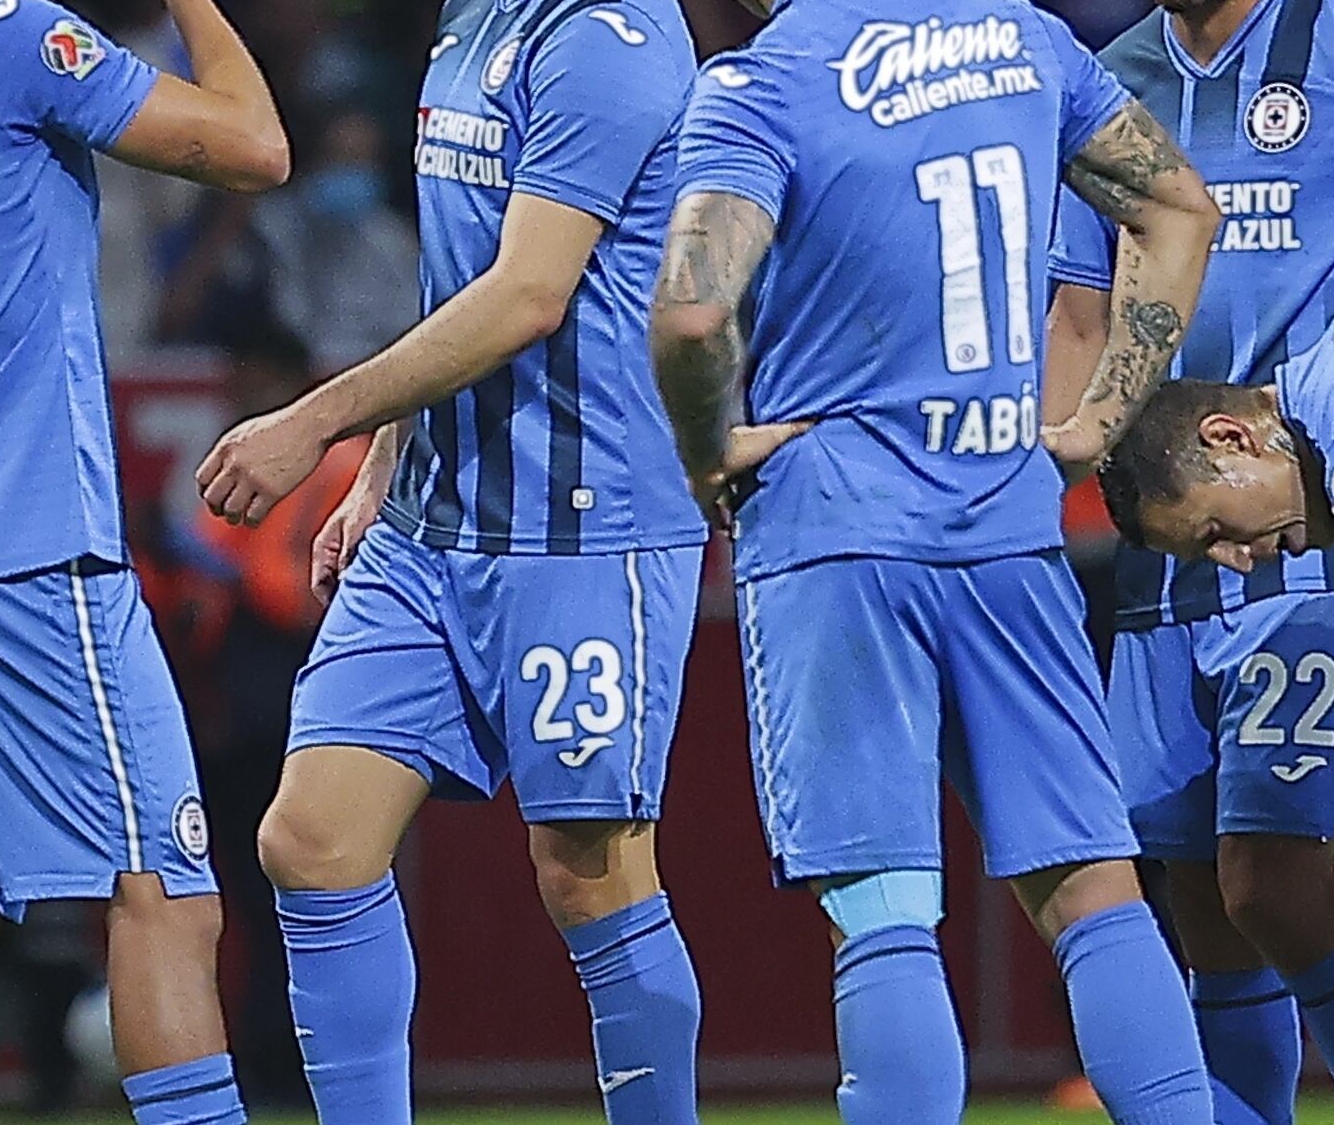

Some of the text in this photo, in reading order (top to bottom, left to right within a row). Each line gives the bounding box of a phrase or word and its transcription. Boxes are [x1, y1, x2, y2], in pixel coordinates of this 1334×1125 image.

[824, 14, 1023, 113] Caliente
[869, 64, 1044, 127] caliente.mx
[915, 143, 1033, 374] 11
[1220, 217, 1303, 252] AZUL
[918, 380, 1037, 456] TABÓ
[520, 638, 628, 743] 23
